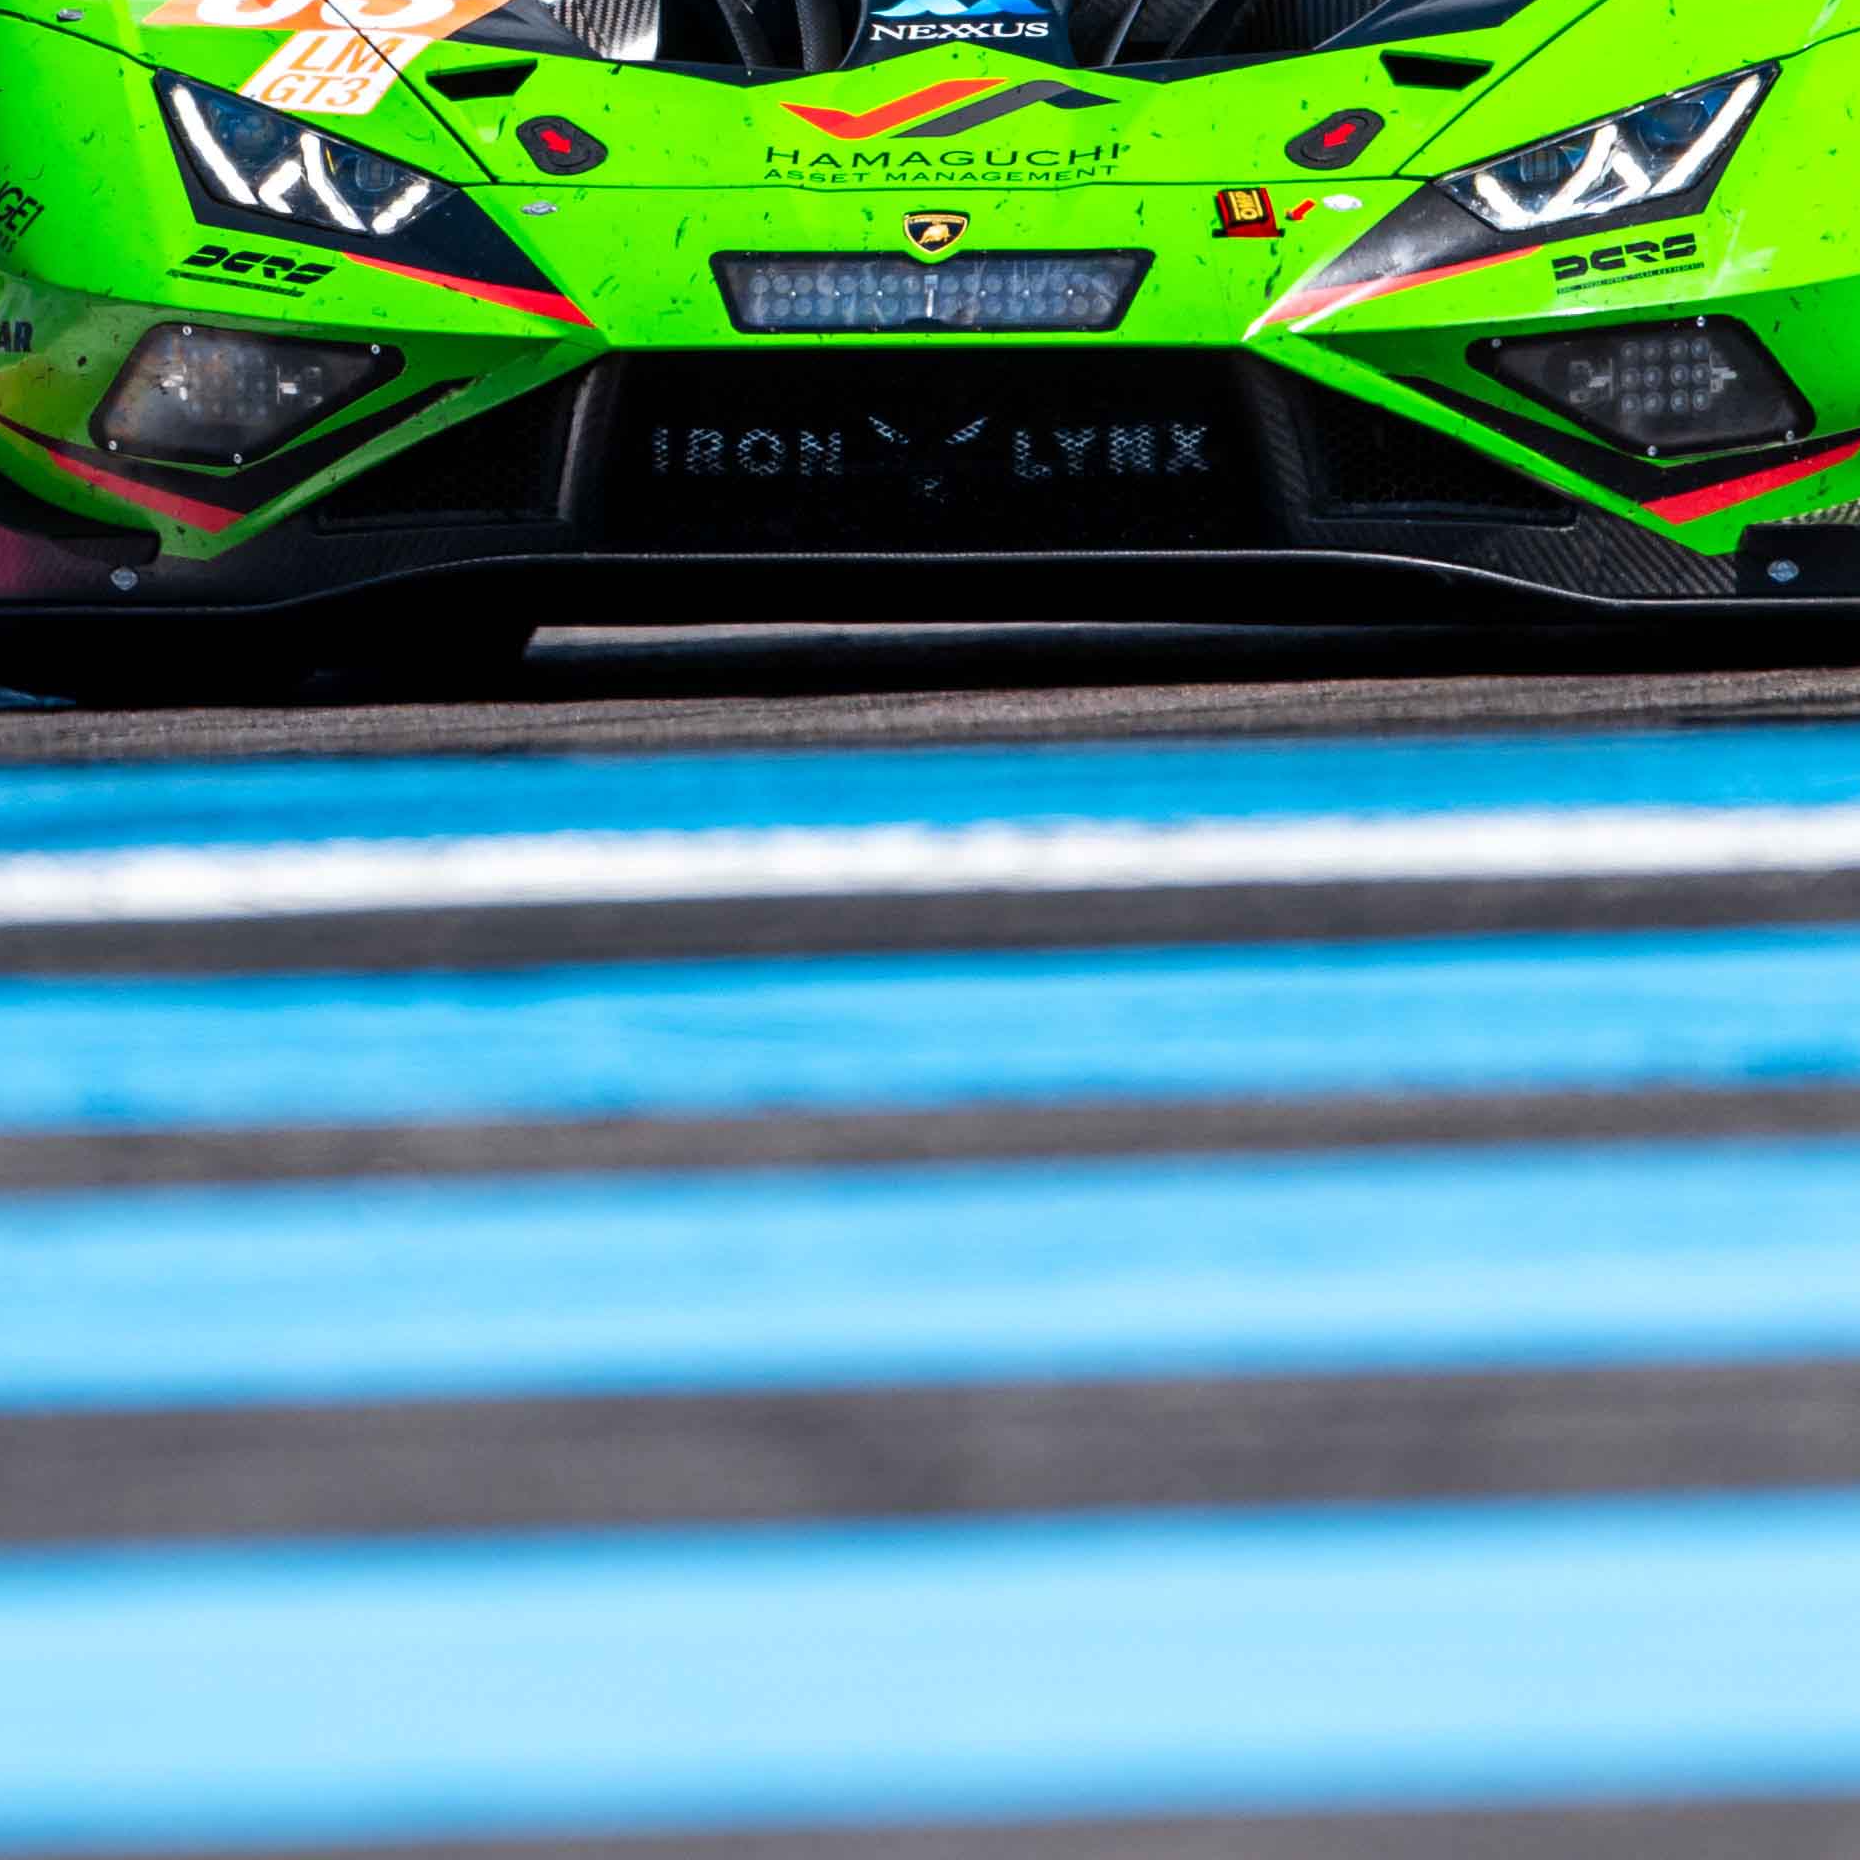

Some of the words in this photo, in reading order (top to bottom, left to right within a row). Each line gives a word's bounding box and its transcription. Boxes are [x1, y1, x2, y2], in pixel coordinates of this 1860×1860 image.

[869, 22, 1050, 41] NEXXUS
[289, 36, 406, 74] LM
[259, 74, 371, 108] GT3
[764, 143, 1121, 169] HAMAGUCHI
[764, 168, 871, 184] ASSET
[884, 164, 1119, 182] MANAGEMENT
[652, 426, 842, 477] IRON
[1011, 421, 1211, 480] LYNX
